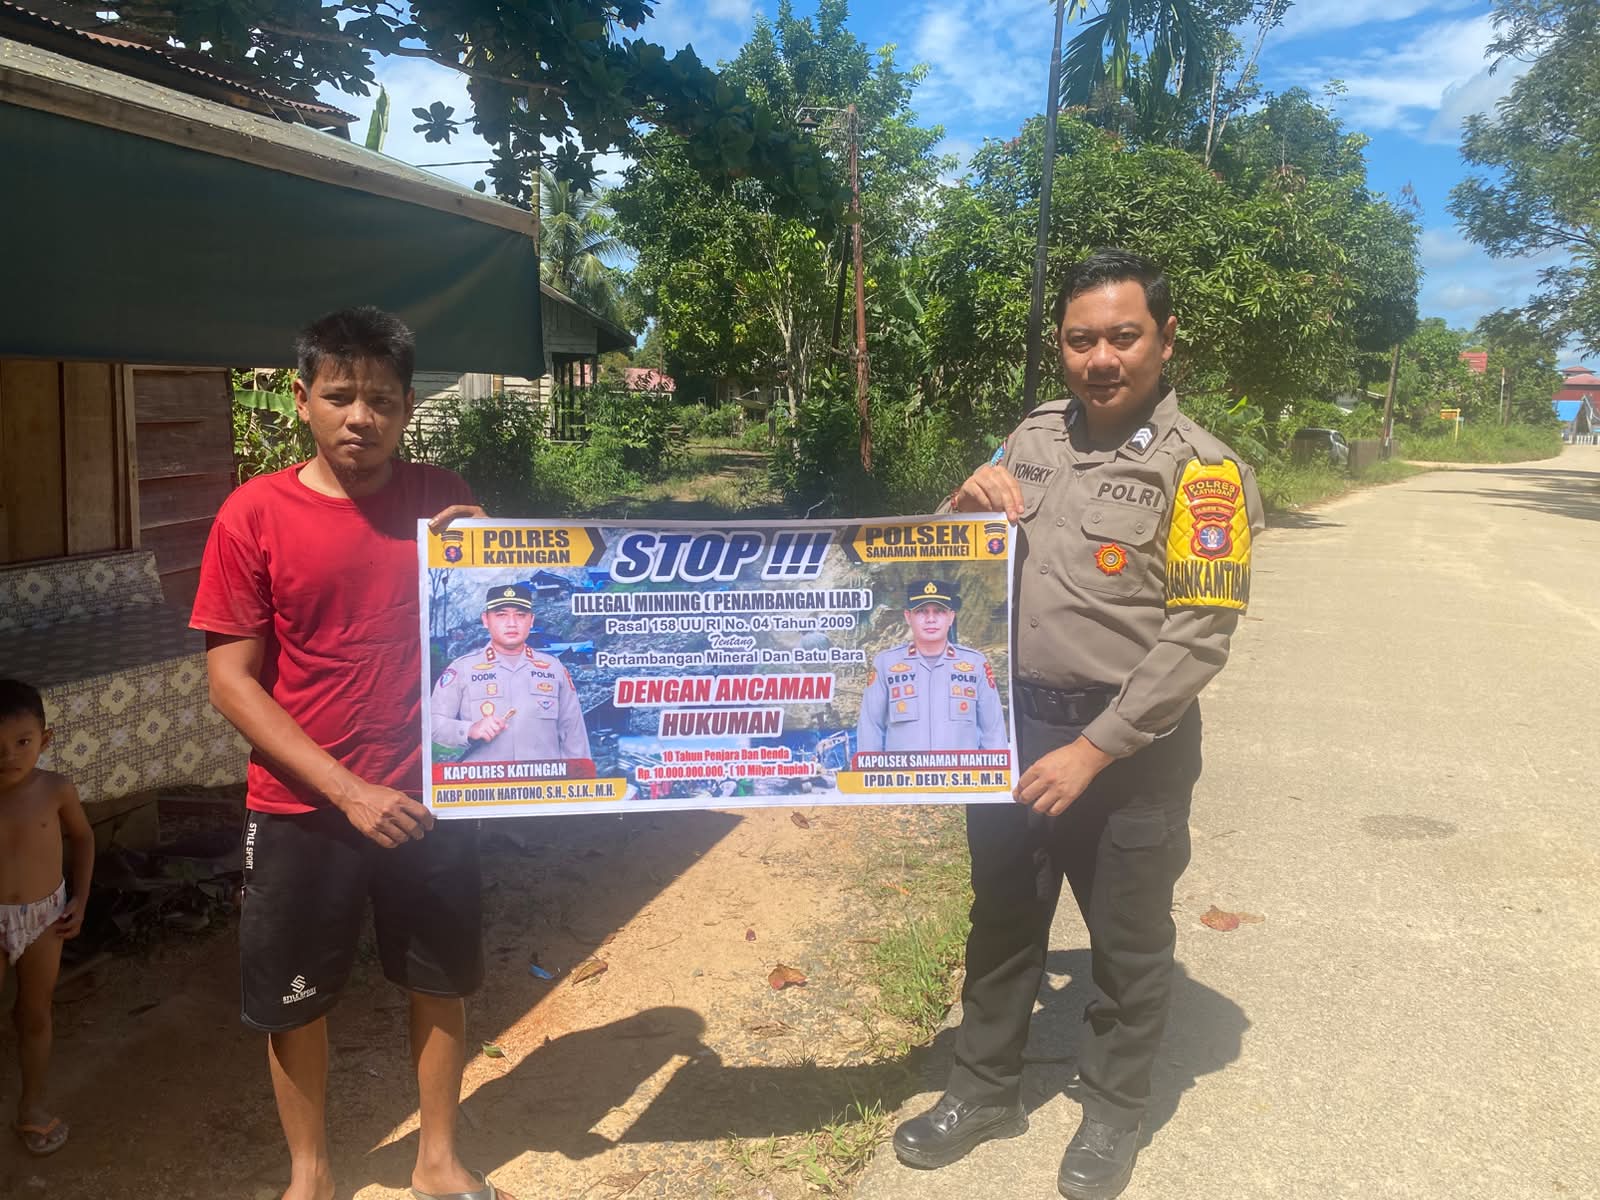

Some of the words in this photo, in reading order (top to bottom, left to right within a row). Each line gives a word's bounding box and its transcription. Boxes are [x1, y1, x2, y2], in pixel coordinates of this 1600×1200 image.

[1013, 461, 1053, 485] YONGKY
[1097, 481, 1162, 508] POLRI
[1188, 480, 1236, 493] POLRES
[483, 529, 570, 549] POLRES
[865, 524, 970, 546] POLSEK
[483, 550, 570, 564] KATINGAN
[612, 531, 763, 580] STOP
[866, 545, 917, 558] SANAMAN
[920, 544, 970, 557] MANTIKEI
[574, 594, 632, 613] ILLEGAL
[634, 593, 701, 612] MINNING
[608, 620, 647, 632] Pasal
[652, 620, 676, 632] 158
[681, 620, 701, 631] UU
[707, 619, 721, 630] RI
[725, 619, 748, 630] No.
[753, 619, 769, 630] 04
[773, 618, 816, 629] Tahun
[821, 617, 853, 628] 2009
[710, 634, 755, 649] Tentang
[599, 653, 702, 667] Pertambangan
[707, 652, 758, 664] Mineral
[763, 652, 790, 663] Dan
[795, 651, 826, 662] Batu
[832, 651, 863, 662] Bara
[471, 673, 497, 682] DODIK
[531, 671, 555, 679] POLRI
[888, 673, 916, 685] DEDY
[951, 673, 977, 684] POLRI
[617, 678, 713, 704] DENGAN
[715, 677, 831, 701] ANCAMAN
[662, 711, 780, 737] HUKUMAN
[663, 751, 673, 762] 10
[675, 750, 702, 762] Tahun
[704, 750, 740, 762] Penjara
[742, 749, 759, 760] Dan
[761, 748, 790, 760] Denda
[857, 755, 908, 768] KAPOLSEK
[910, 754, 959, 767] SANAMAN
[960, 754, 1008, 767] MANTIKEI
[443, 764, 505, 780] KAPOLRES
[508, 762, 567, 778] KATINGAN
[637, 768, 651, 780] Rp.
[747, 764, 775, 777] Milyar
[864, 774, 893, 787] IPDA
[896, 774, 913, 787] Dr.
[916, 773, 949, 787] DEDY,
[951, 773, 978, 786] S.H.,
[980, 773, 1007, 785] M.H.
[436, 789, 462, 803] AKBP
[465, 788, 495, 802] DODIK
[595, 784, 615, 797] M.H.
[246, 822, 257, 846] STYLE
[245, 846, 254, 870] SPORT
